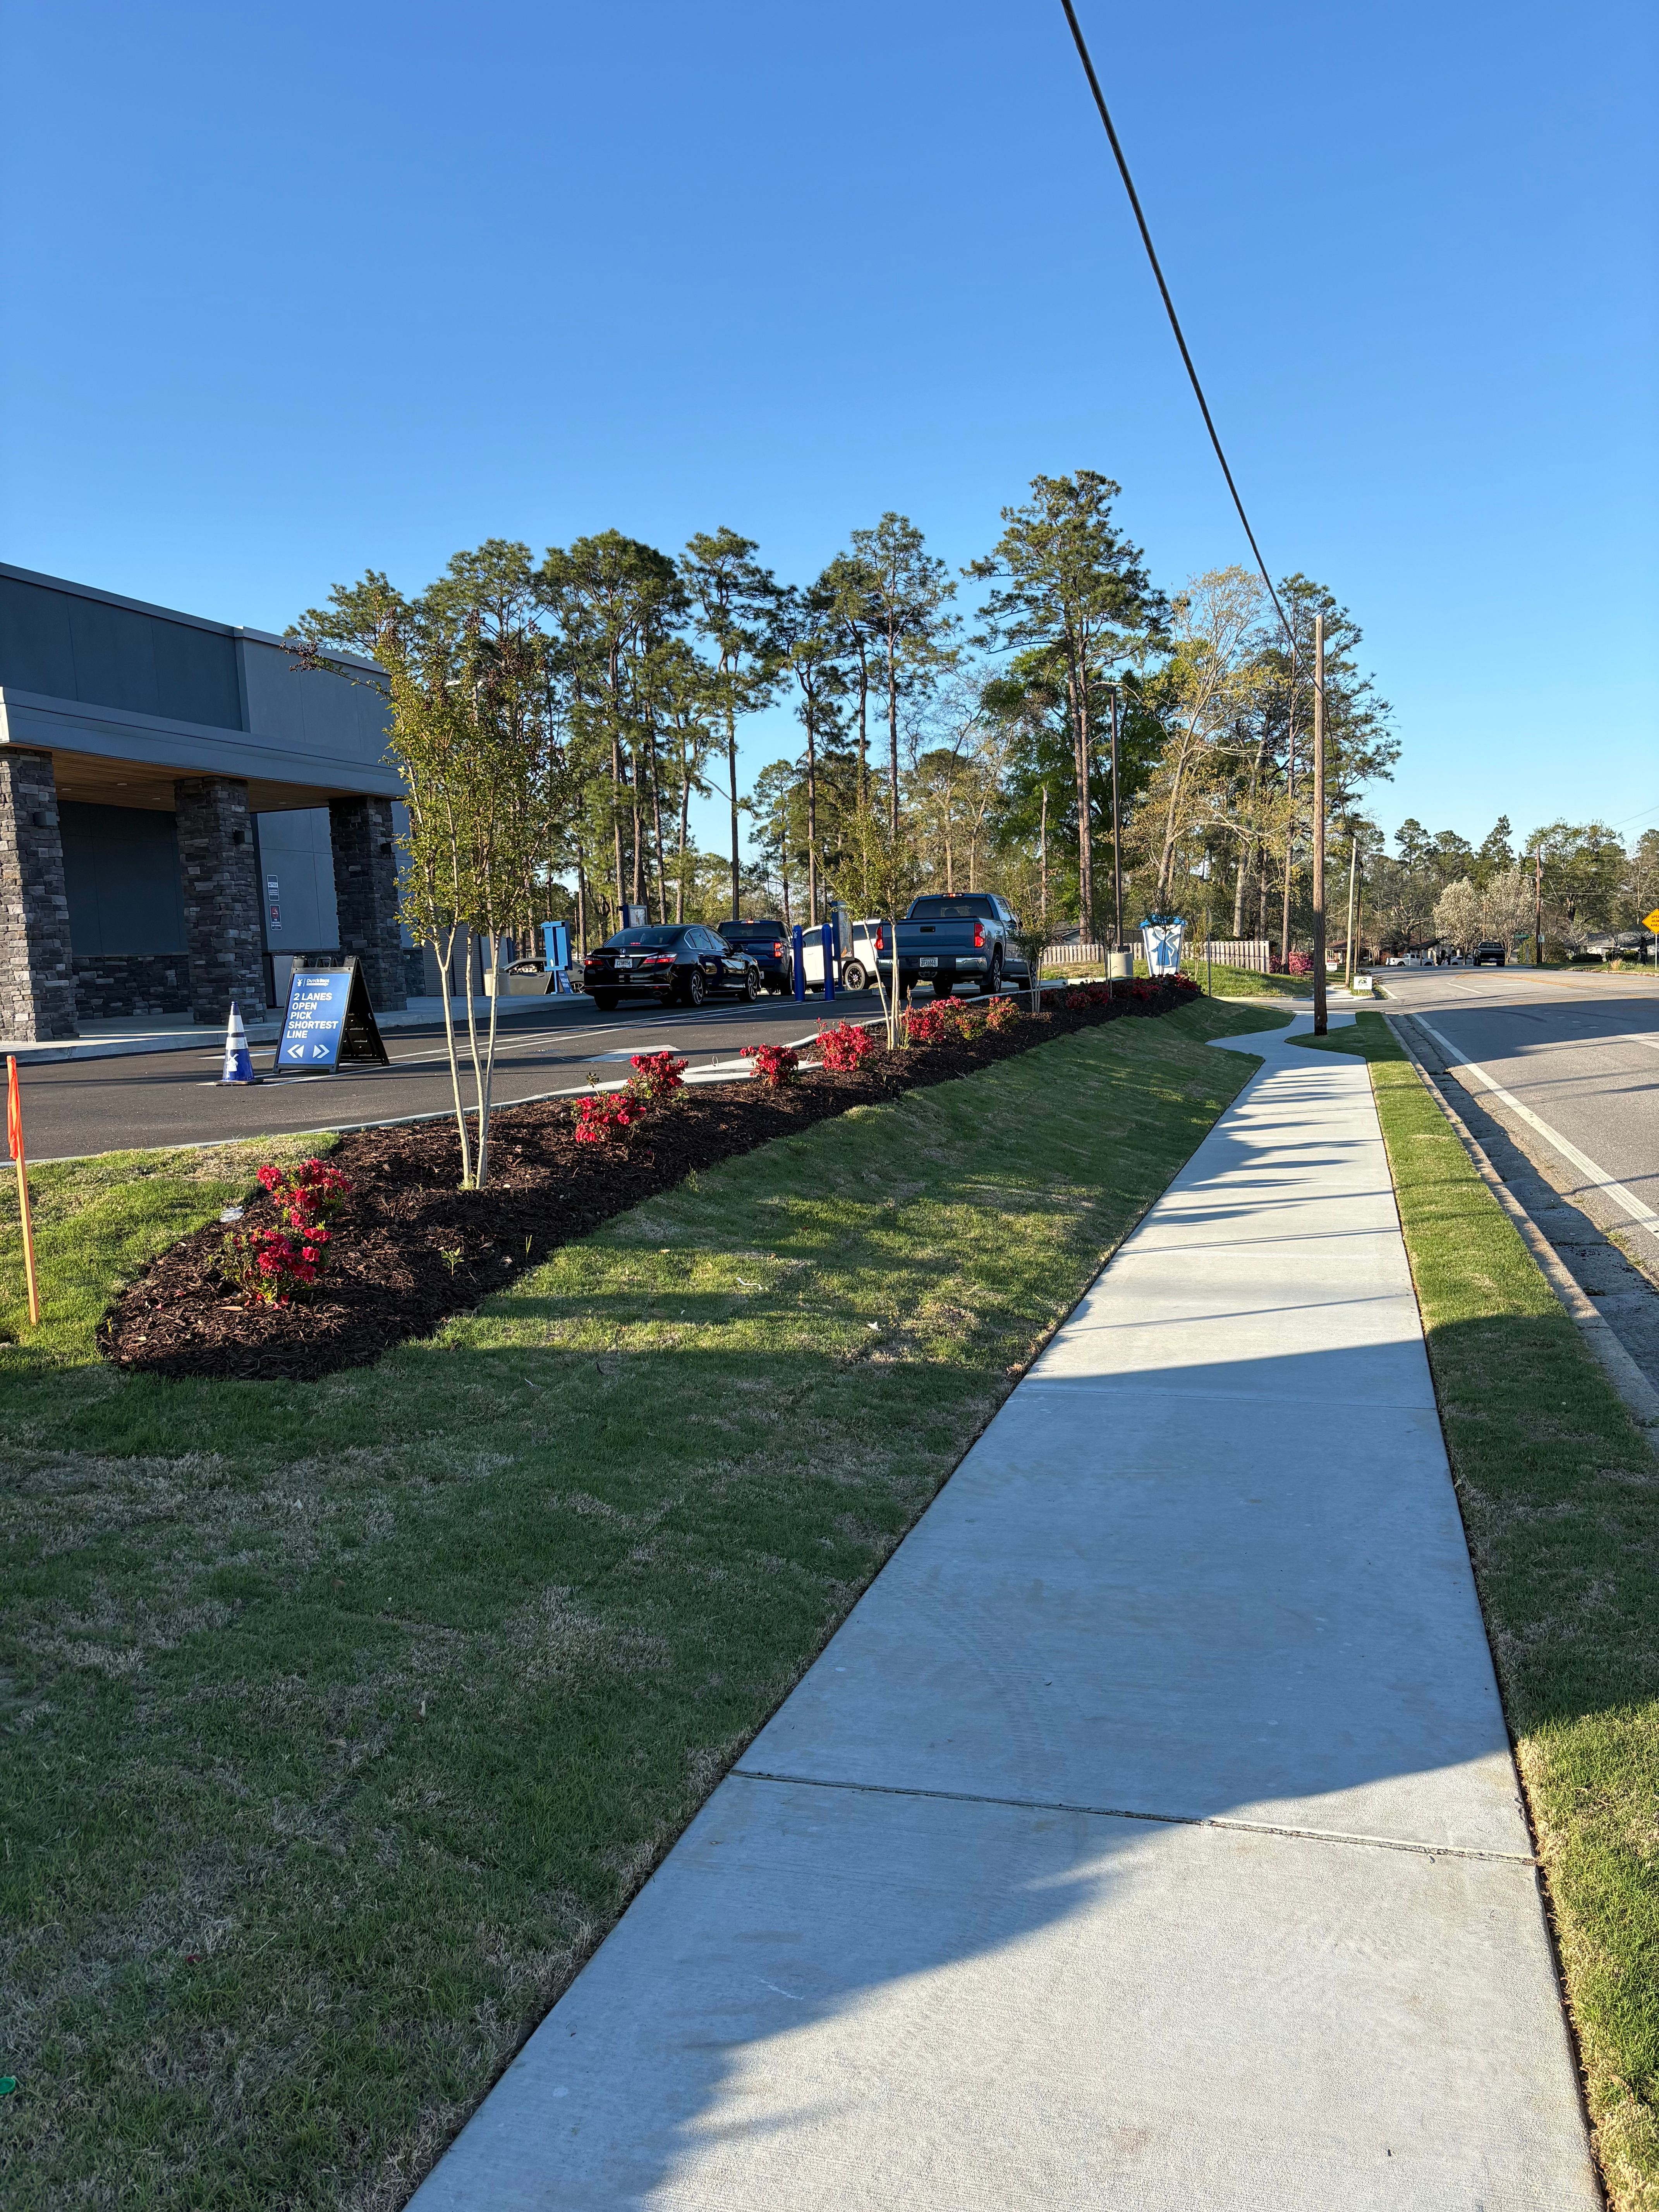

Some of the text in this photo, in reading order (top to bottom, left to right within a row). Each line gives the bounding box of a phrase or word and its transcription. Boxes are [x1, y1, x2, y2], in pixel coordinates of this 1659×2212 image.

[293, 992, 333, 1001] 2 LANES
[292, 1002, 317, 1010] OPEN
[290, 1012, 313, 1020] PICK
[288, 1021, 339, 1029] SHORTEST
[287, 1030, 308, 1038] LINE
